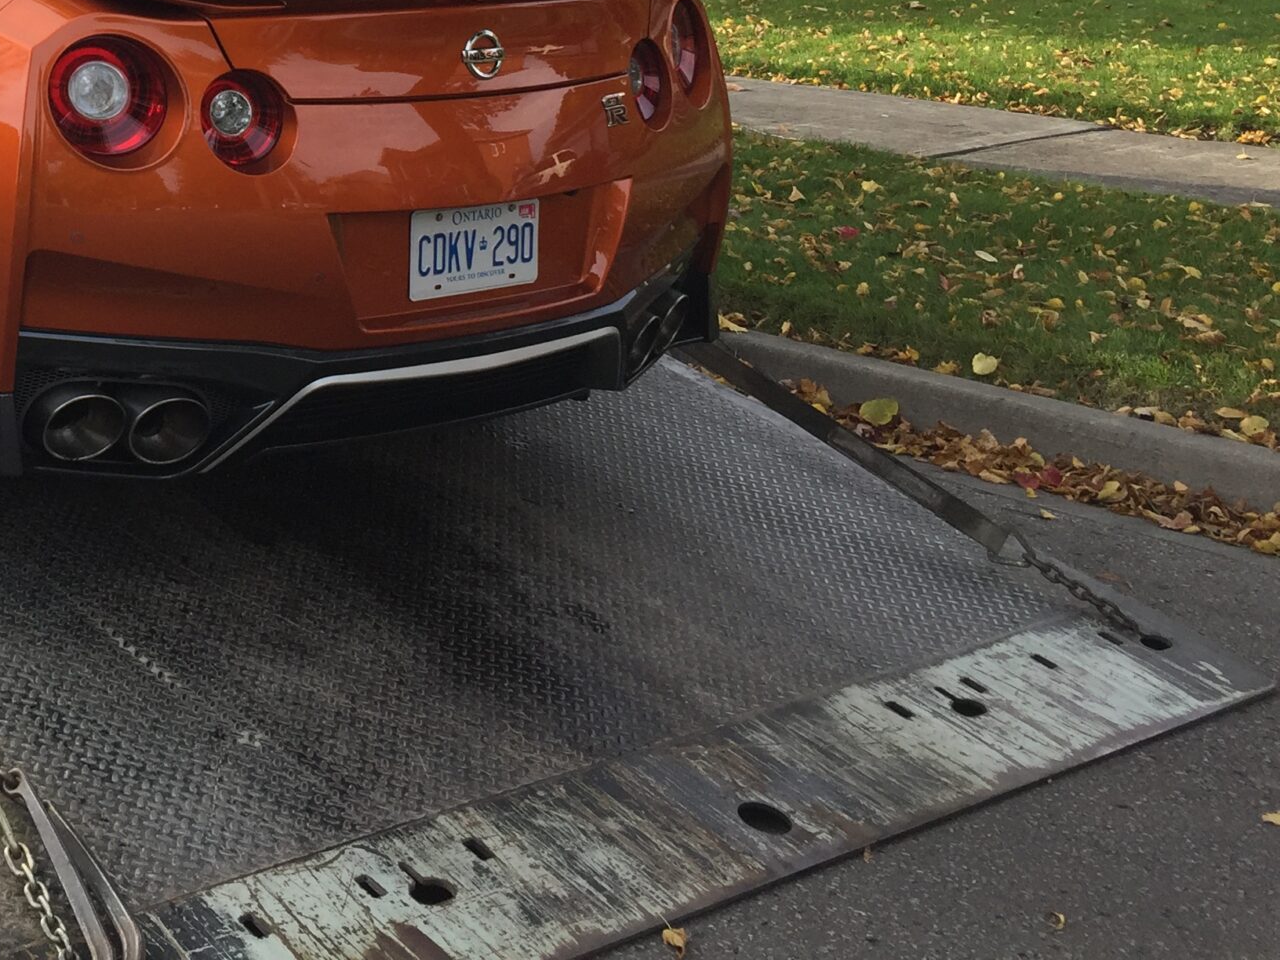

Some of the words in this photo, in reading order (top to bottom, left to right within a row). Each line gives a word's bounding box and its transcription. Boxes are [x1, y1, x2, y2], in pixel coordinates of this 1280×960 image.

[452, 207, 502, 226] ONTARIO
[418, 229, 477, 277] CDKV
[492, 222, 534, 267] 290
